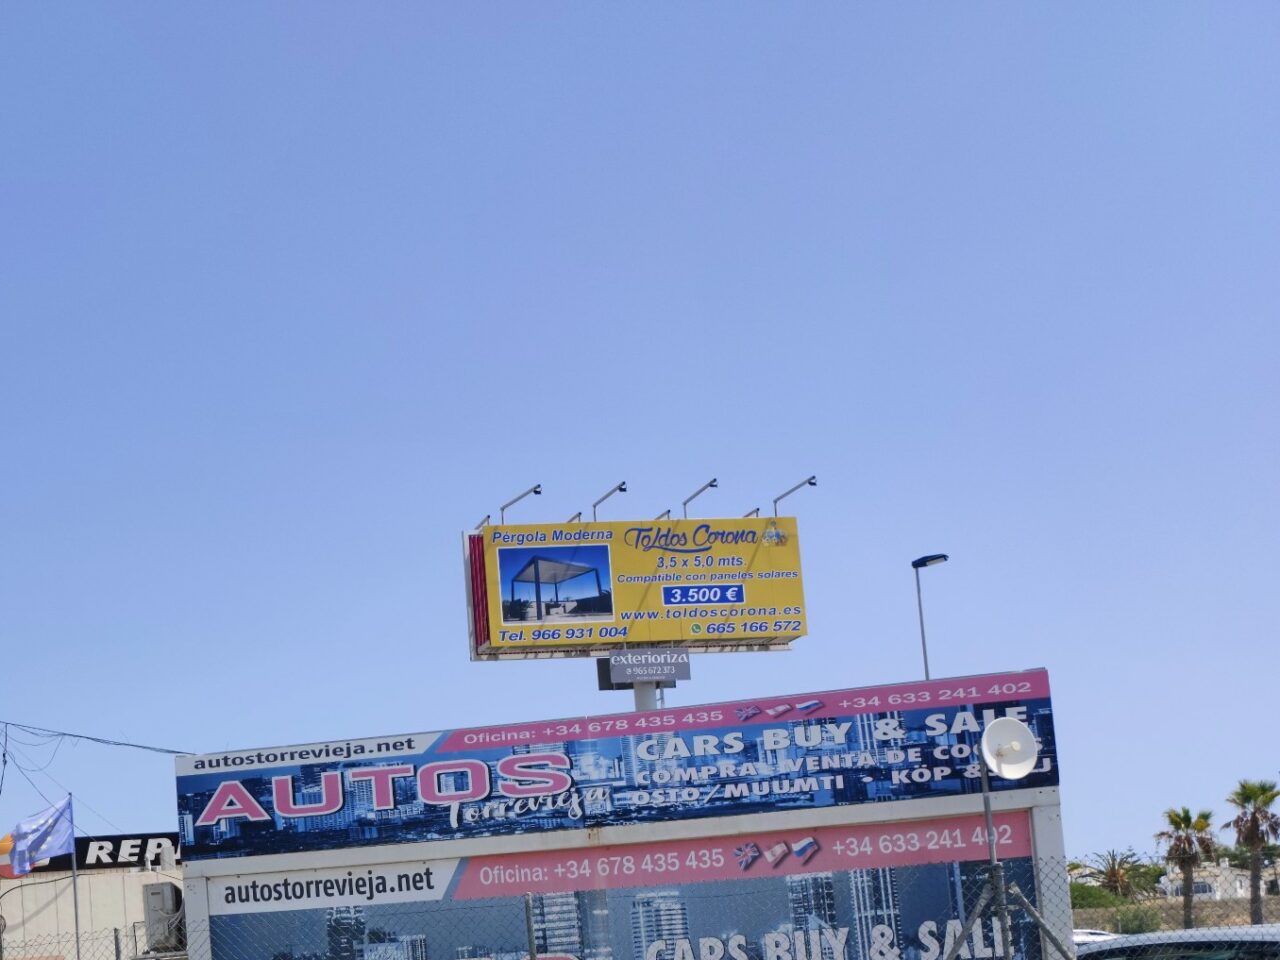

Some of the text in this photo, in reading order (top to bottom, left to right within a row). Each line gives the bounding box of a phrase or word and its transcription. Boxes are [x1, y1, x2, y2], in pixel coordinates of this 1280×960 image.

[492, 529, 613, 545] Pérgola Moderna
[624, 524, 758, 552] Toldos Corona
[657, 556, 677, 569] 3,5
[681, 559, 688, 568] x
[694, 556, 714, 568] 5,0
[617, 570, 798, 584] Compatible con paneles solares
[670, 587, 738, 602] 3.500 €
[620, 606, 801, 620] www.toldoscorona.es
[499, 626, 628, 641] Tel. 966 931 004
[706, 620, 802, 634] 665 166 572
[611, 650, 688, 665] exterioriza
[839, 682, 1031, 709] +34 633 241 402
[464, 711, 723, 744] Oficina: +34 678 435 435
[637, 731, 745, 760] CARS
[763, 722, 852, 751] BUY
[873, 718, 907, 740] &
[193, 737, 416, 771] autostorrevieja.net
[636, 762, 758, 784] COMPRA
[790, 750, 877, 772] VENTA
[887, 748, 921, 765] DE
[891, 763, 952, 784] KÖP
[195, 752, 574, 827] AUTOS
[439, 786, 610, 829] Torrevieja
[85, 837, 181, 864] REP
[832, 836, 872, 858] +34
[879, 832, 919, 853] 633
[926, 829, 967, 850] 241
[479, 847, 724, 886] Oficina: +34 678 435 435
[224, 867, 435, 904] autostorrevieja.net
